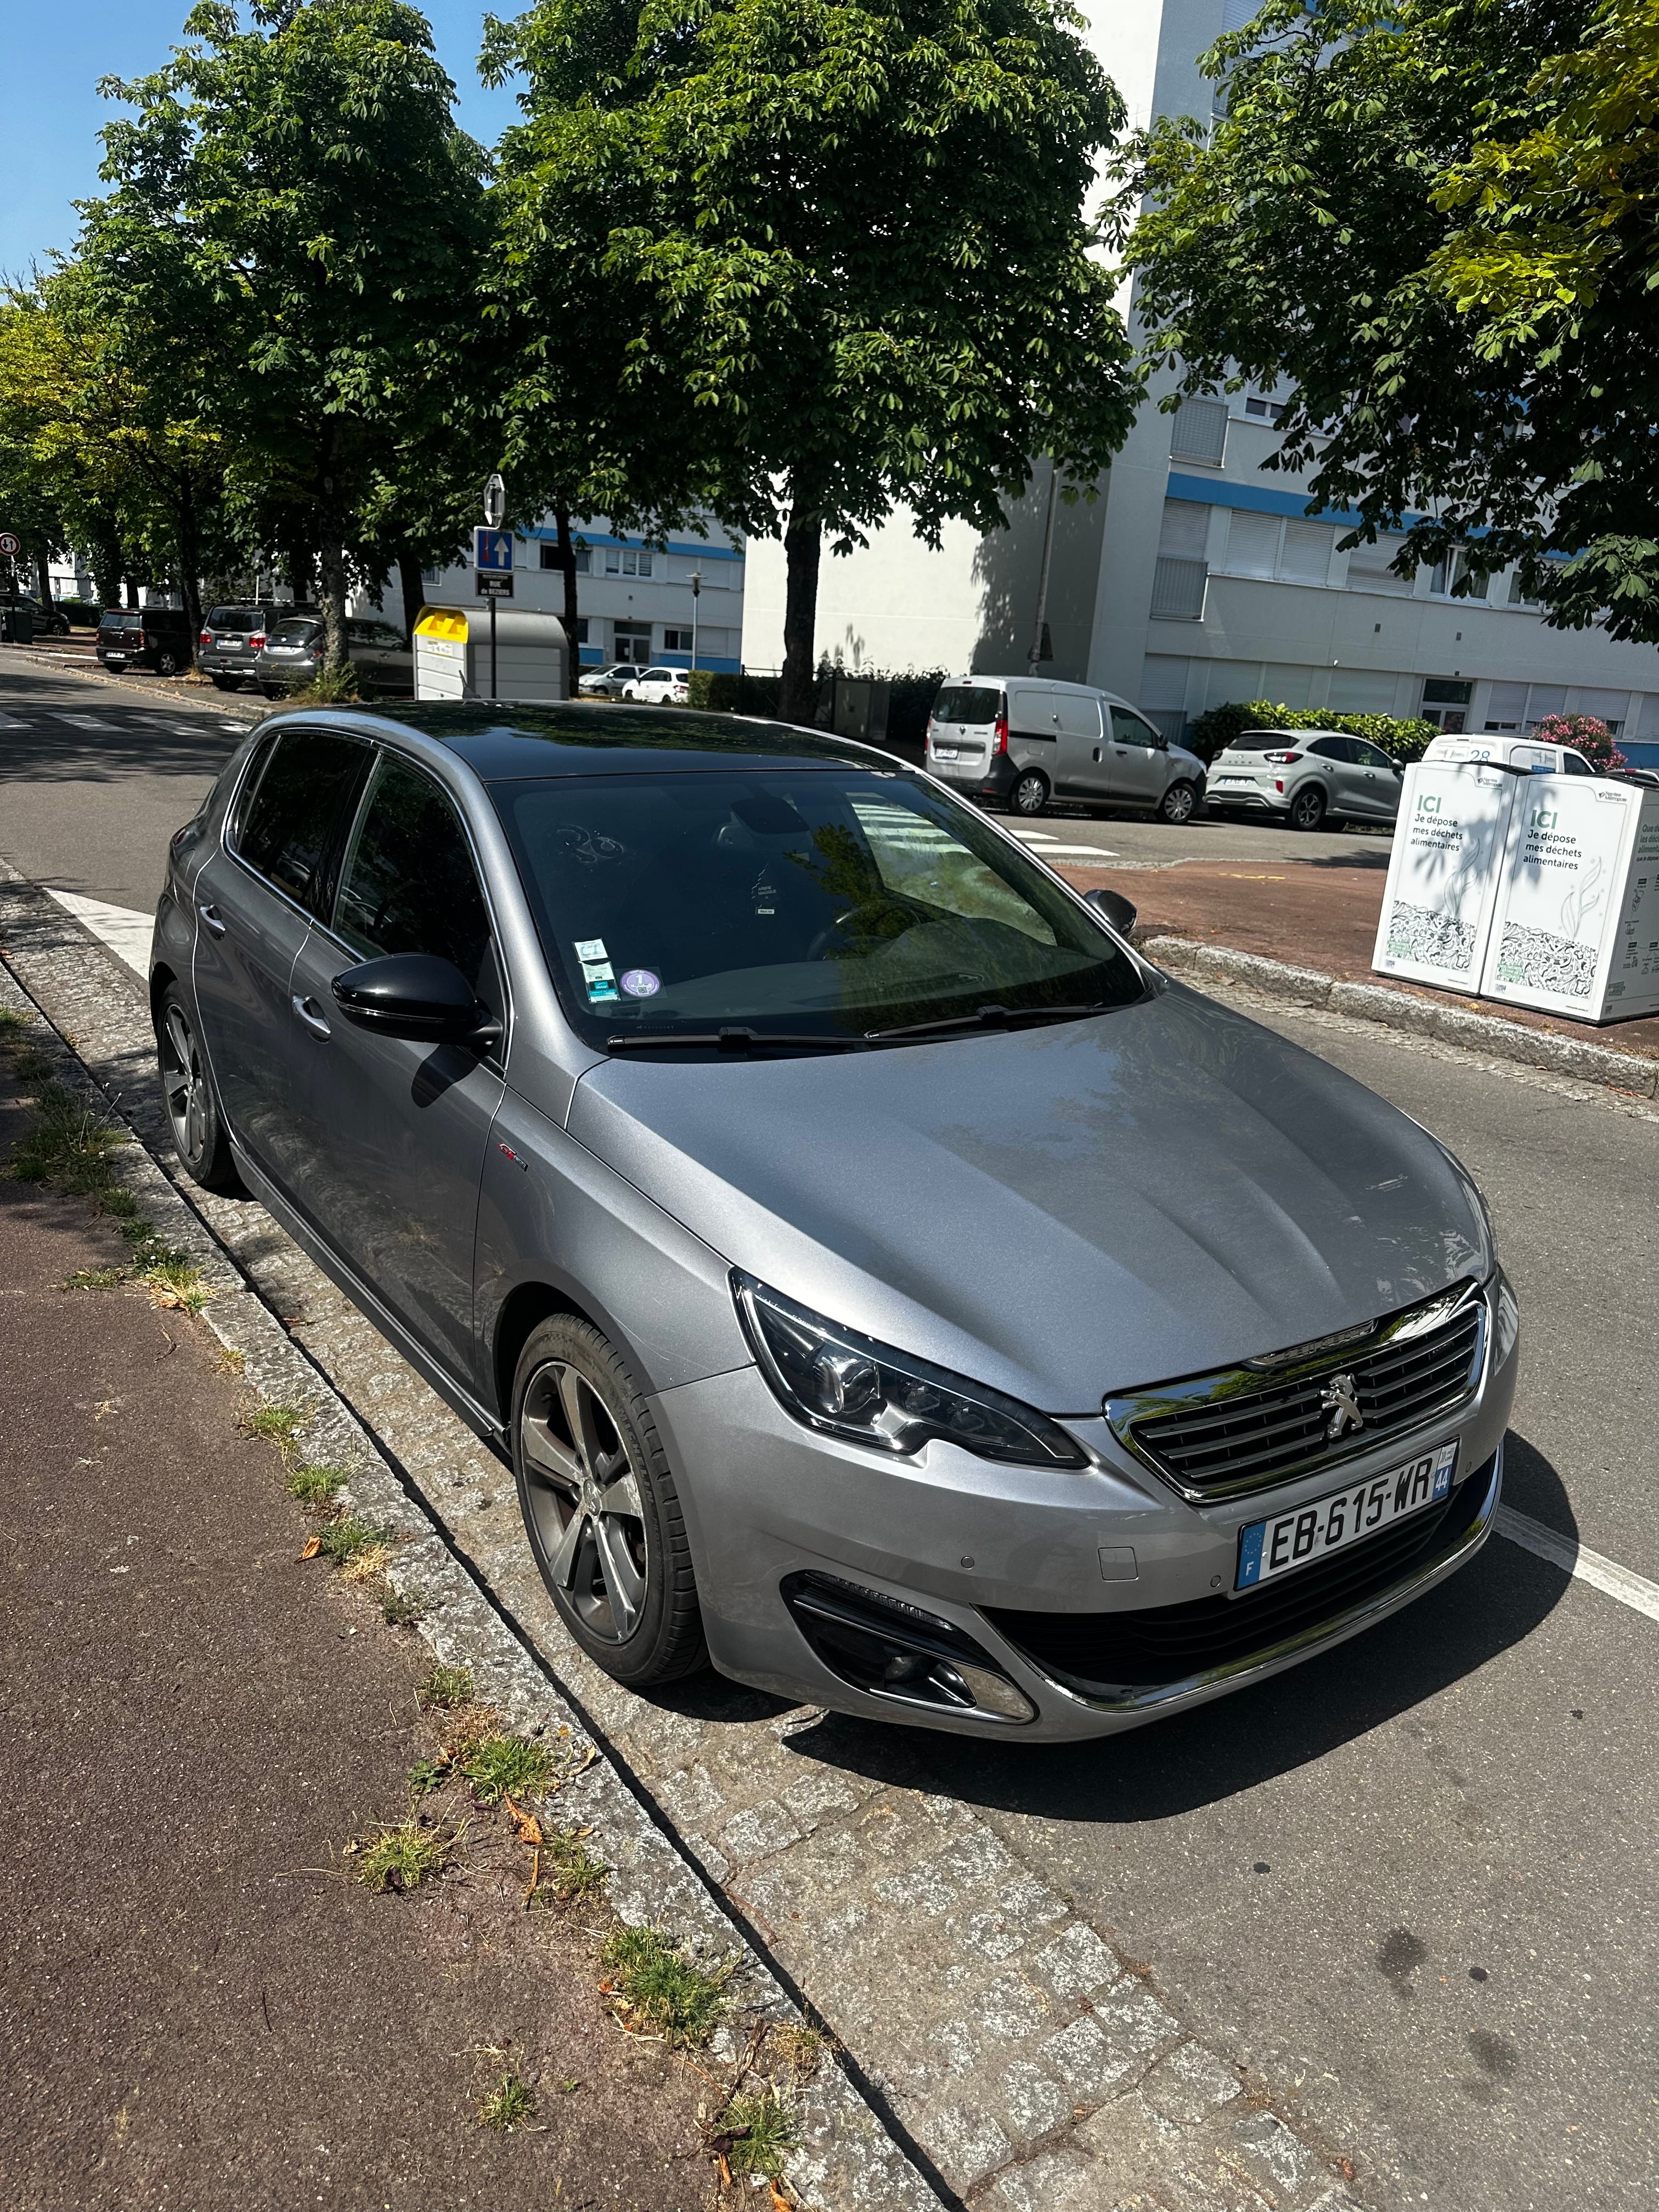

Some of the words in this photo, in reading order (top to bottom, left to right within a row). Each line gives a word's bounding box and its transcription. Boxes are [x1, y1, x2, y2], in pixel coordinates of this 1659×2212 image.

[1471, 749, 1490, 761] 28
[1417, 795, 1441, 813] ICI
[1415, 814, 1425, 822] Je
[1427, 815, 1458, 827] dépose
[1530, 810, 1558, 829] ICI
[1413, 827, 1429, 835] mes
[1431, 828, 1463, 840] déchets
[1643, 824, 1654, 832] Que
[1410, 837, 1459, 851] alimentaires
[1527, 830, 1539, 839] Je
[1541, 832, 1576, 844] dépose
[1526, 844, 1543, 852] mes
[1546, 845, 1582, 857] déchets
[1523, 855, 1578, 870] alimentaires
[636, 974, 642, 984] 1
[618, 1408, 654, 1503] MICHELIN
[1435, 1467, 1449, 1492] 44
[1269, 1458, 1432, 1570] EB-615-WR
[1245, 1561, 1254, 1576] F
